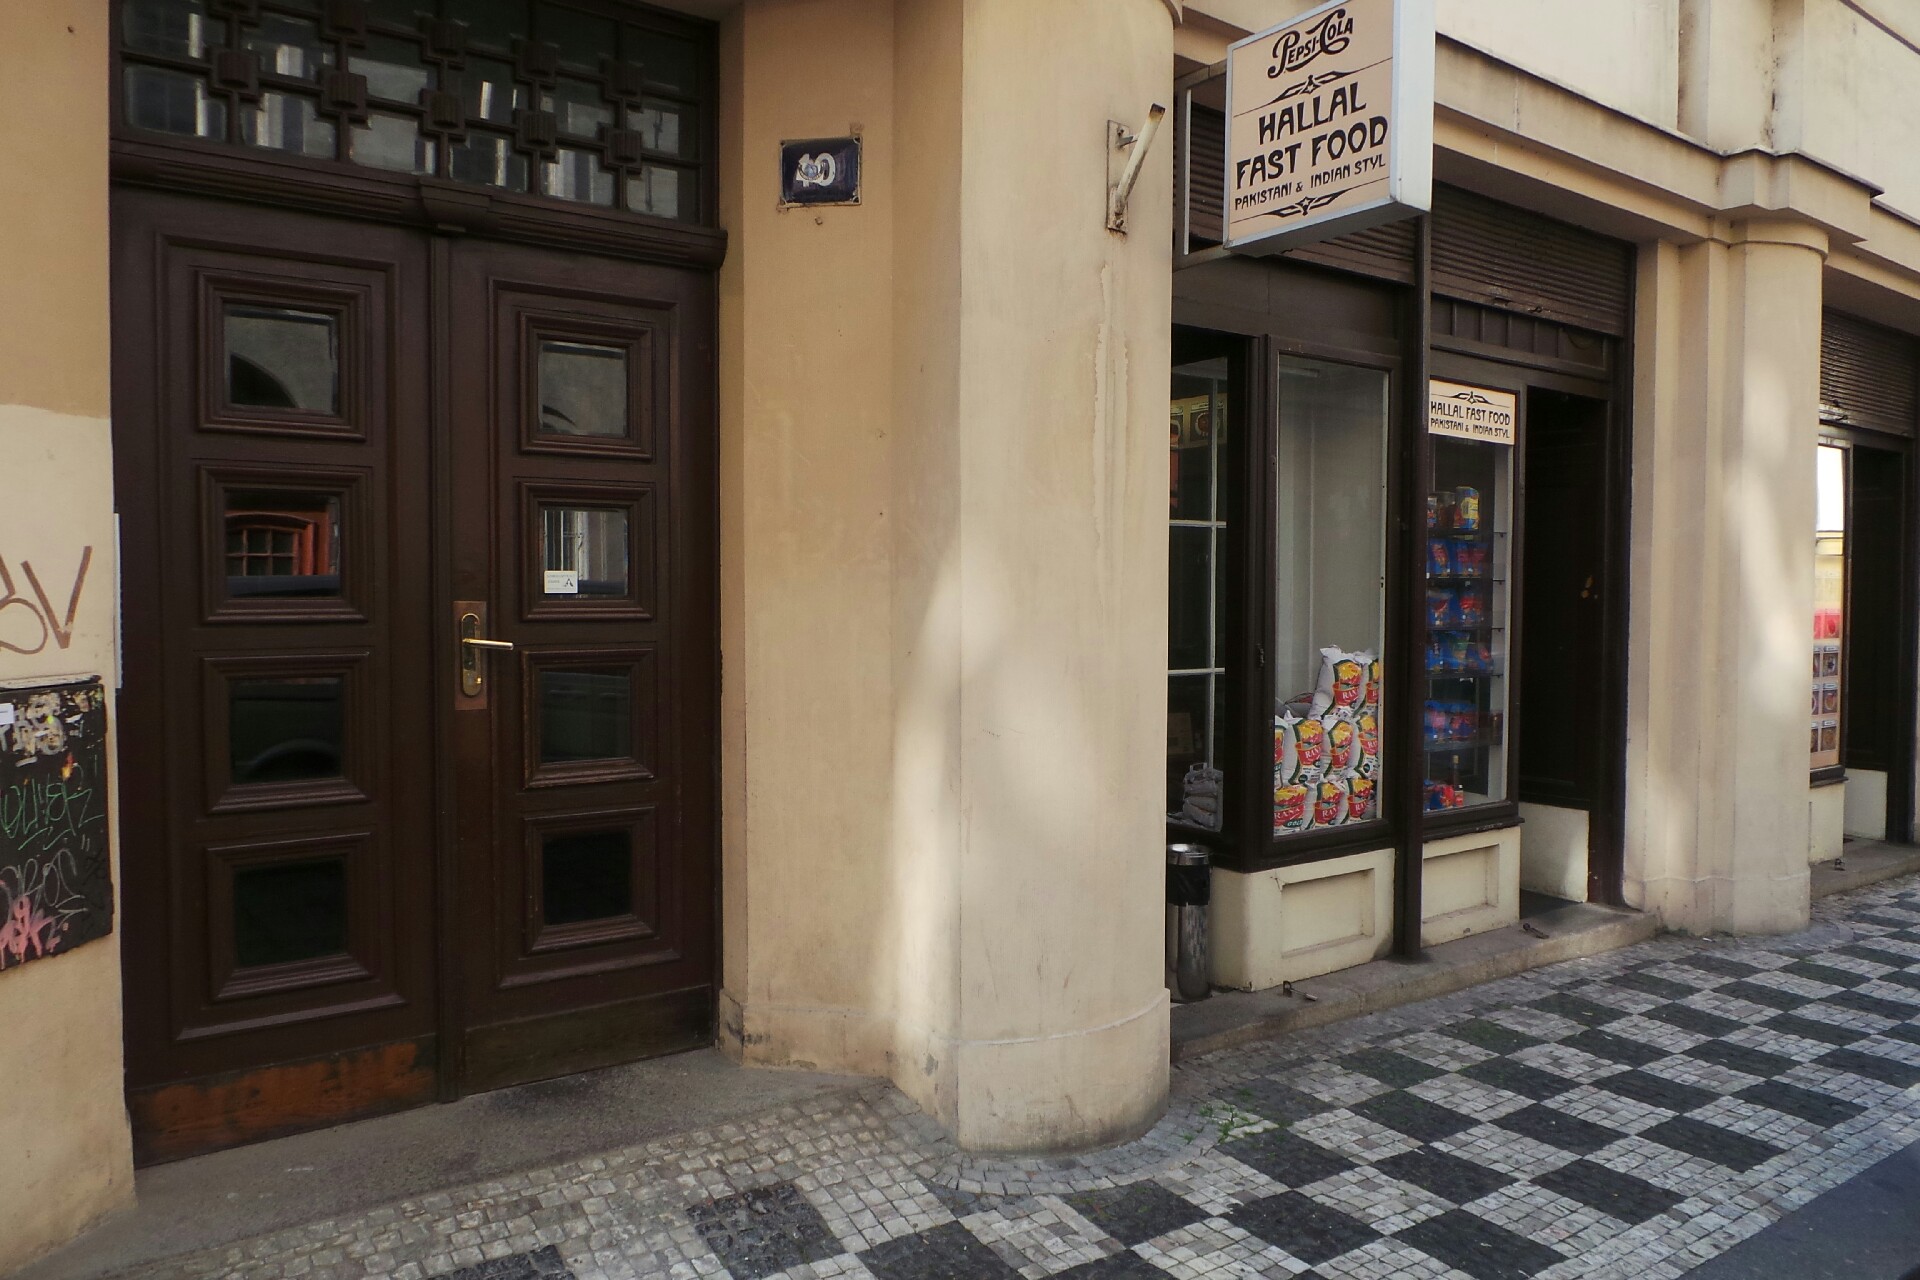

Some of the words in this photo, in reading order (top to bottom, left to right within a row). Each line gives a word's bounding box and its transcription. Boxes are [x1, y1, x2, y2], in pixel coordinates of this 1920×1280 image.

[1258, 82, 1367, 145] HALLAL
[1236, 142, 1302, 190] FAST
[1311, 115, 1388, 167] FOOD
[1235, 182, 1292, 210] PAKISTANI
[1296, 181, 1303, 193] &
[1310, 163, 1351, 189] INDIAN
[1354, 153, 1386, 175] STYL
[1430, 401, 1464, 419] HALLAL
[1466, 406, 1486, 421] FAST
[1488, 410, 1511, 426] FOOD
[1430, 417, 1464, 431] PAKISTANI
[1472, 423, 1493, 436] INDIAN
[1494, 429, 1510, 439] STYL
